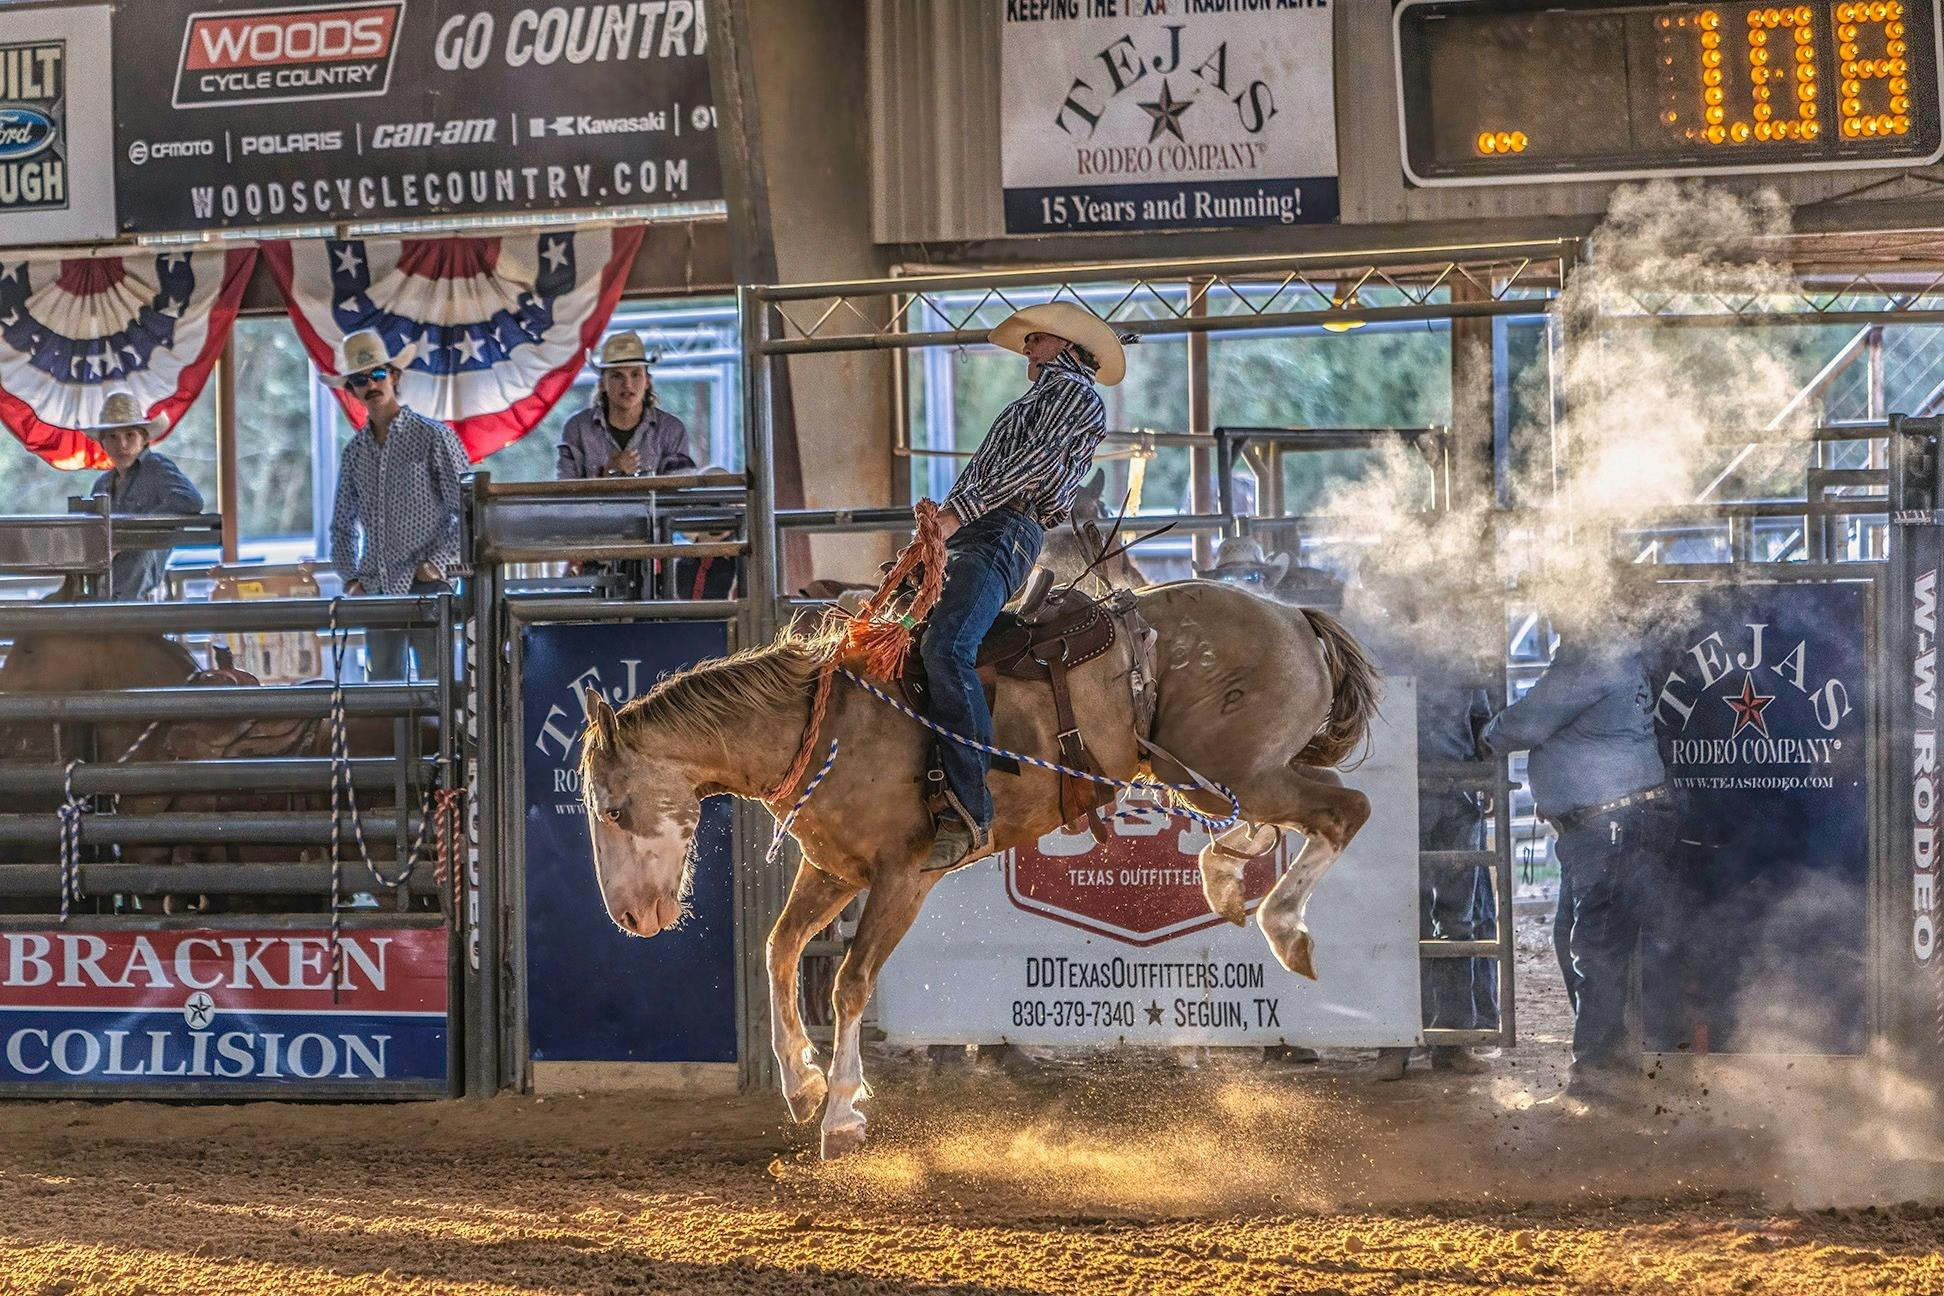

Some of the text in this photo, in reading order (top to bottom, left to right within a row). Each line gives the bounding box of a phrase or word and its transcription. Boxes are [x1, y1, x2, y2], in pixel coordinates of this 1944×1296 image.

[1007, 0, 1079, 21] KEEPING
[1087, 0, 1117, 18] THE
[200, 16, 384, 63] WOODS
[434, 11, 494, 70] GO
[0, 48, 61, 99] ILT
[201, 64, 379, 92] CYCLE COUNTRY
[1054, 24, 1279, 141] TEJAS
[241, 131, 342, 155] POLARIS
[372, 118, 497, 149] can-am
[577, 111, 666, 135] Kawasaki
[0, 161, 64, 204] UGH
[1077, 146, 1152, 176] RODEO
[191, 158, 688, 219] WOODSCYCLECOUNTRY.COM
[1041, 187, 1303, 225] 15 Years and Running!
[1653, 623, 1853, 732] TEJAS
[535, 660, 642, 762] TEJ
[1672, 739, 1737, 765] RODEO
[1673, 776, 1833, 790] WWW.TEJASRODEO.COM
[1912, 730, 1936, 966] RODEO
[1068, 867, 1203, 886] TEXAS OUTFITTER
[2, 934, 392, 991] BRACKEN
[1012, 1000, 1135, 1028] 830-379-7340
[1254, 1000, 1280, 1028] TX
[6, 1028, 392, 1080] COLLISION
